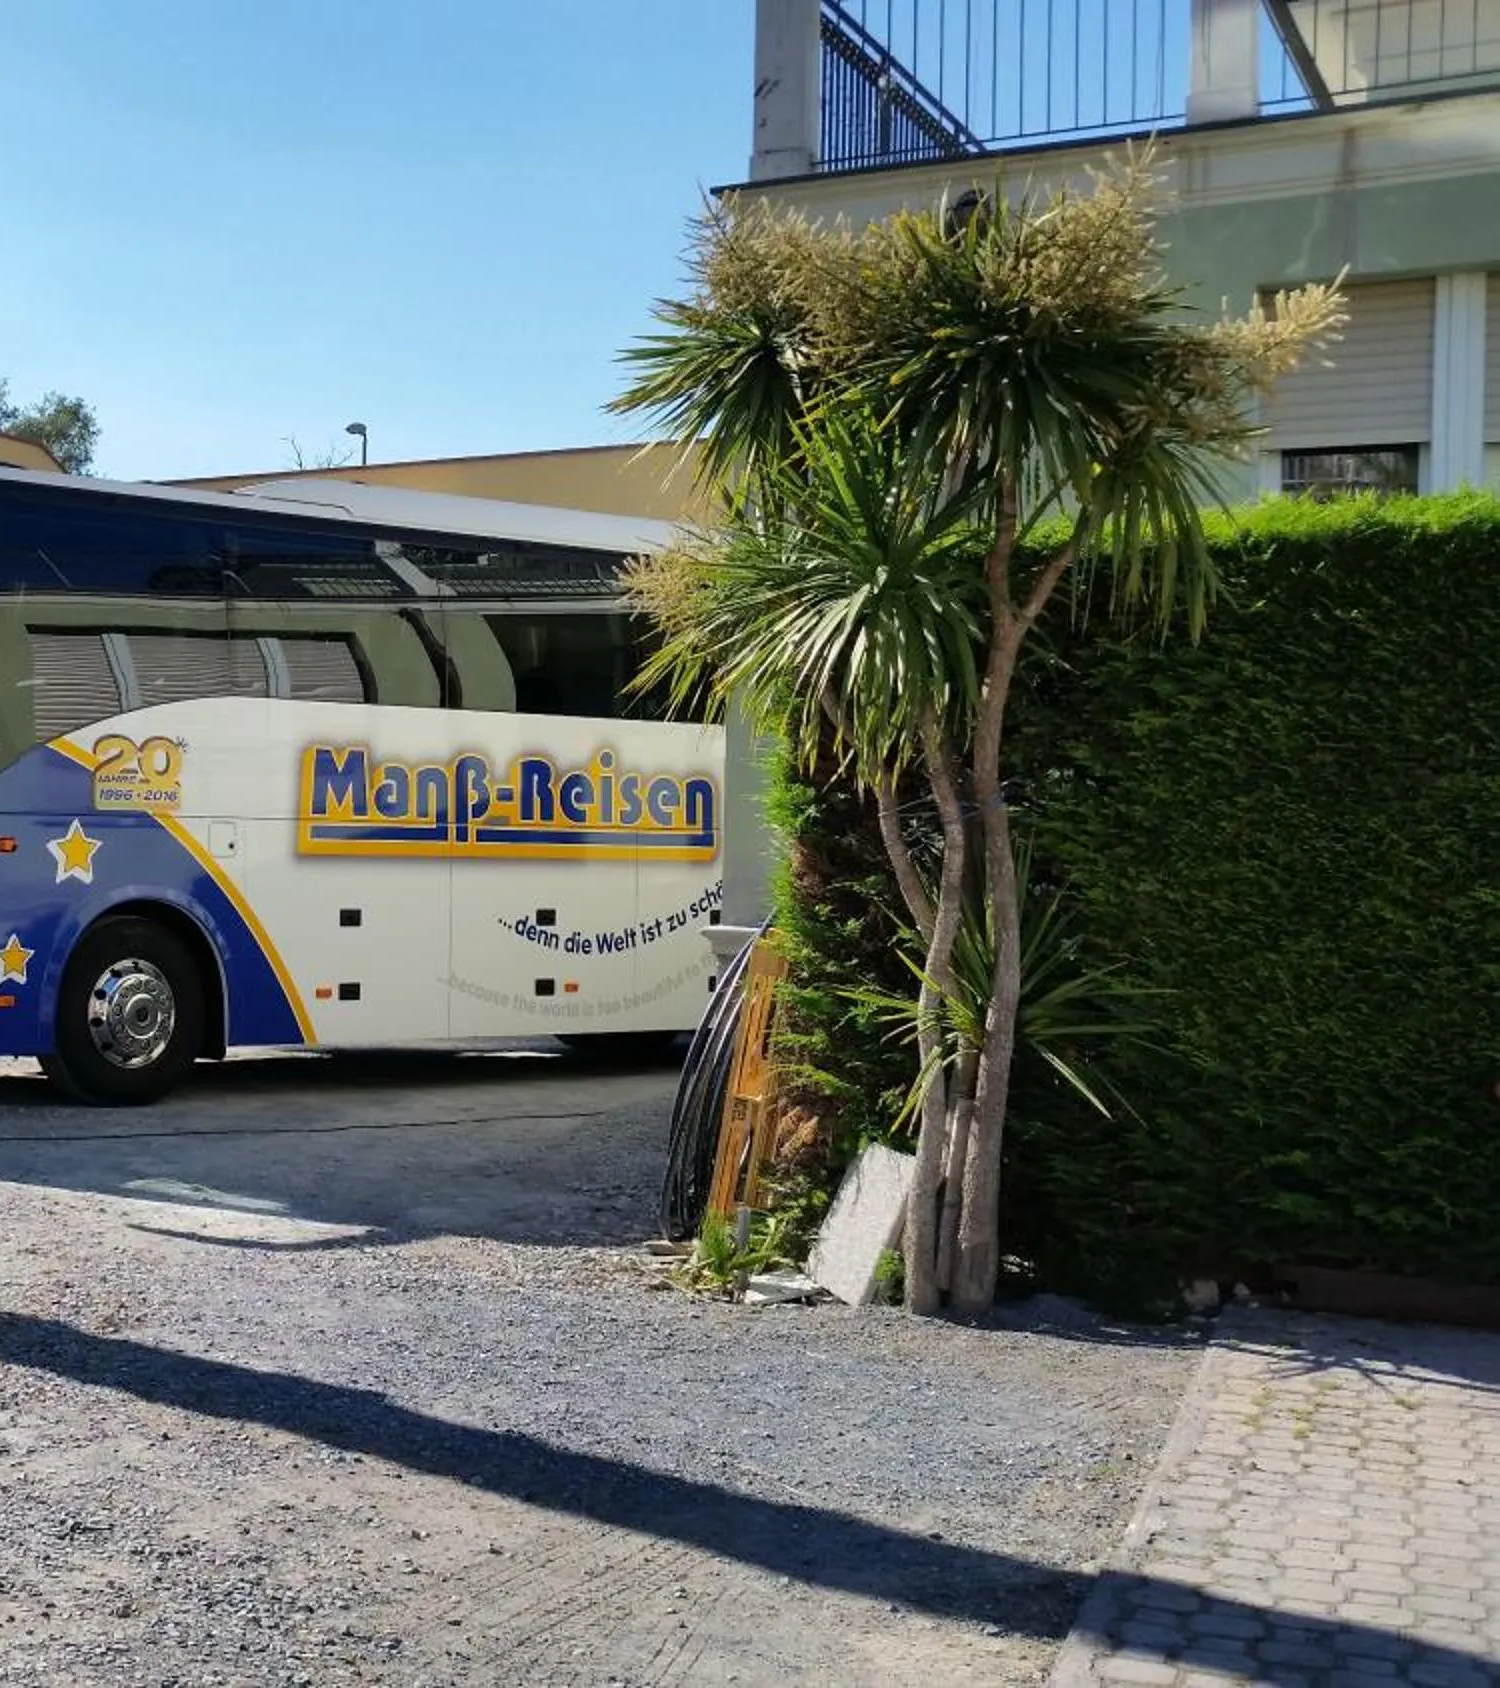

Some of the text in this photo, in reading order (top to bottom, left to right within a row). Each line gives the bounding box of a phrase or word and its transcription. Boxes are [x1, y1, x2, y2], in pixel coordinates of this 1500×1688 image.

[310, 745, 716, 847] Manß-Reisen
[564, 931, 592, 955] die
[595, 928, 637, 955] Welt
[639, 918, 663, 945] ist
[666, 909, 688, 933] zu
